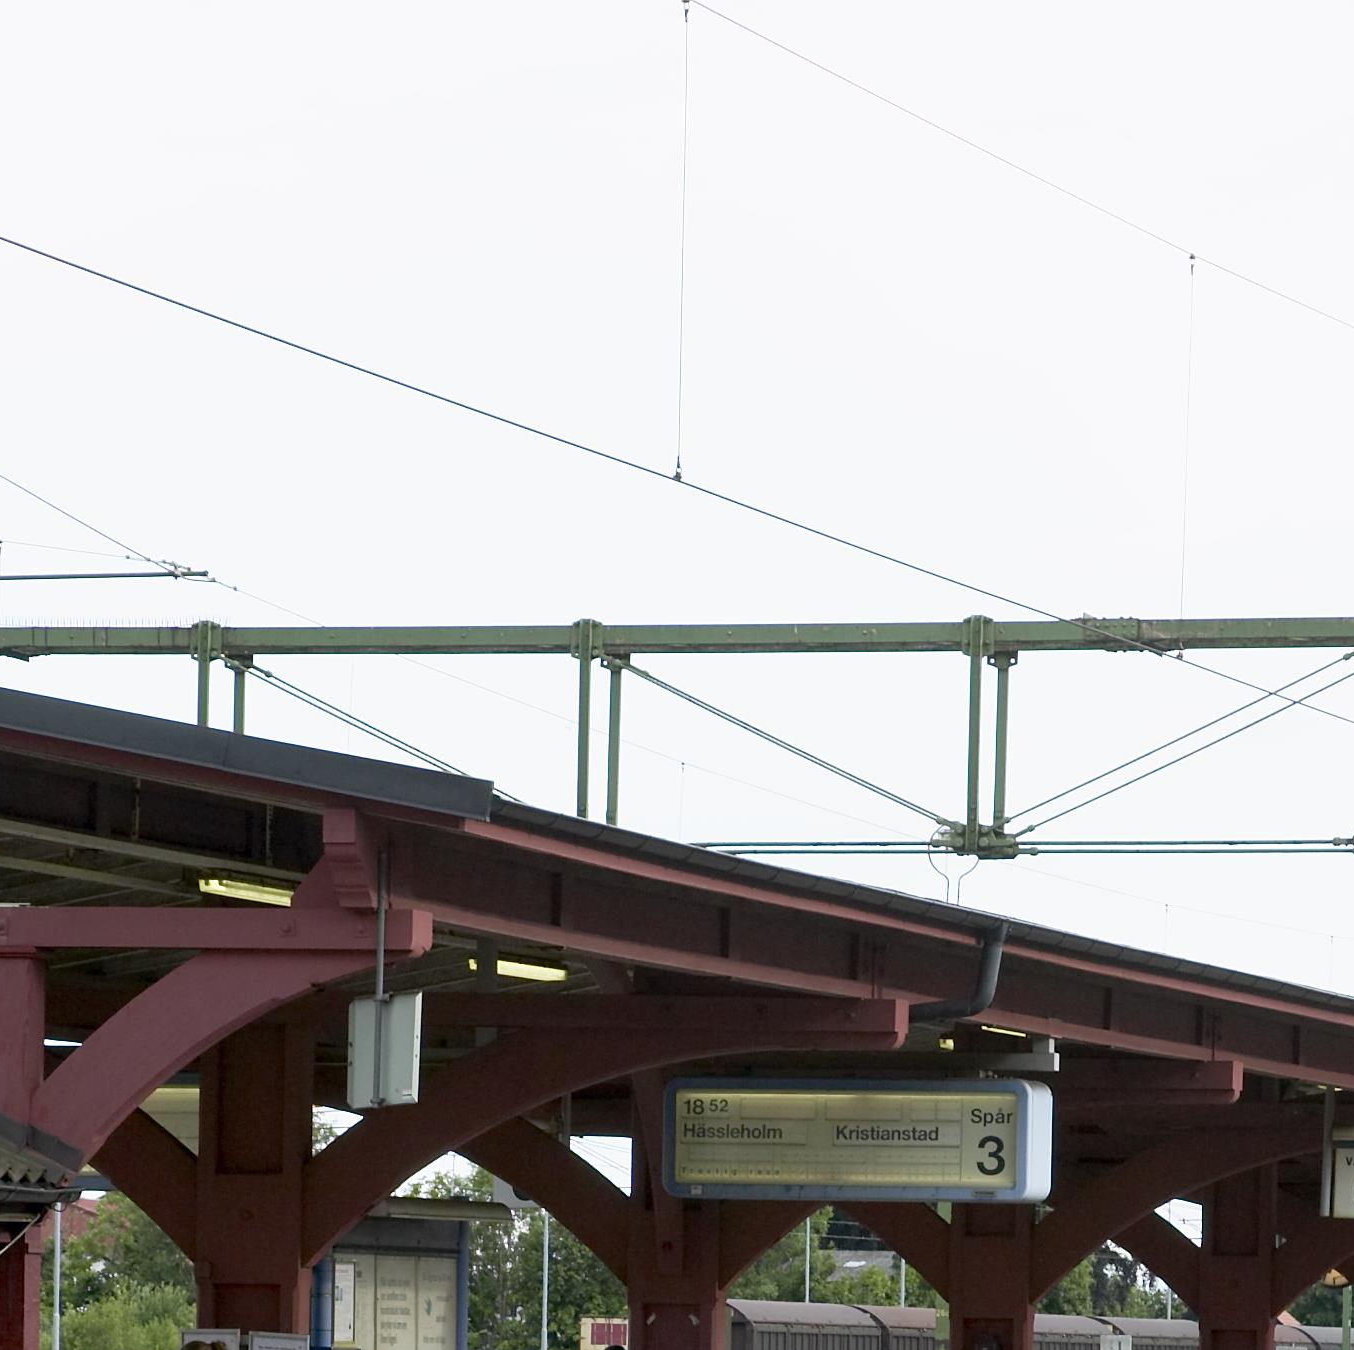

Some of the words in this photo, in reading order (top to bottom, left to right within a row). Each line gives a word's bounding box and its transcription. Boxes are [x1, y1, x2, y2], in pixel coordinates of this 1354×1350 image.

[683, 1100, 705, 1115] 18
[709, 1100, 729, 1113] 52
[970, 1108, 1014, 1127] Spår
[683, 1123, 783, 1140] Hässleholm
[835, 1126, 939, 1141] Kristianstad
[976, 1135, 1006, 1176] 3
